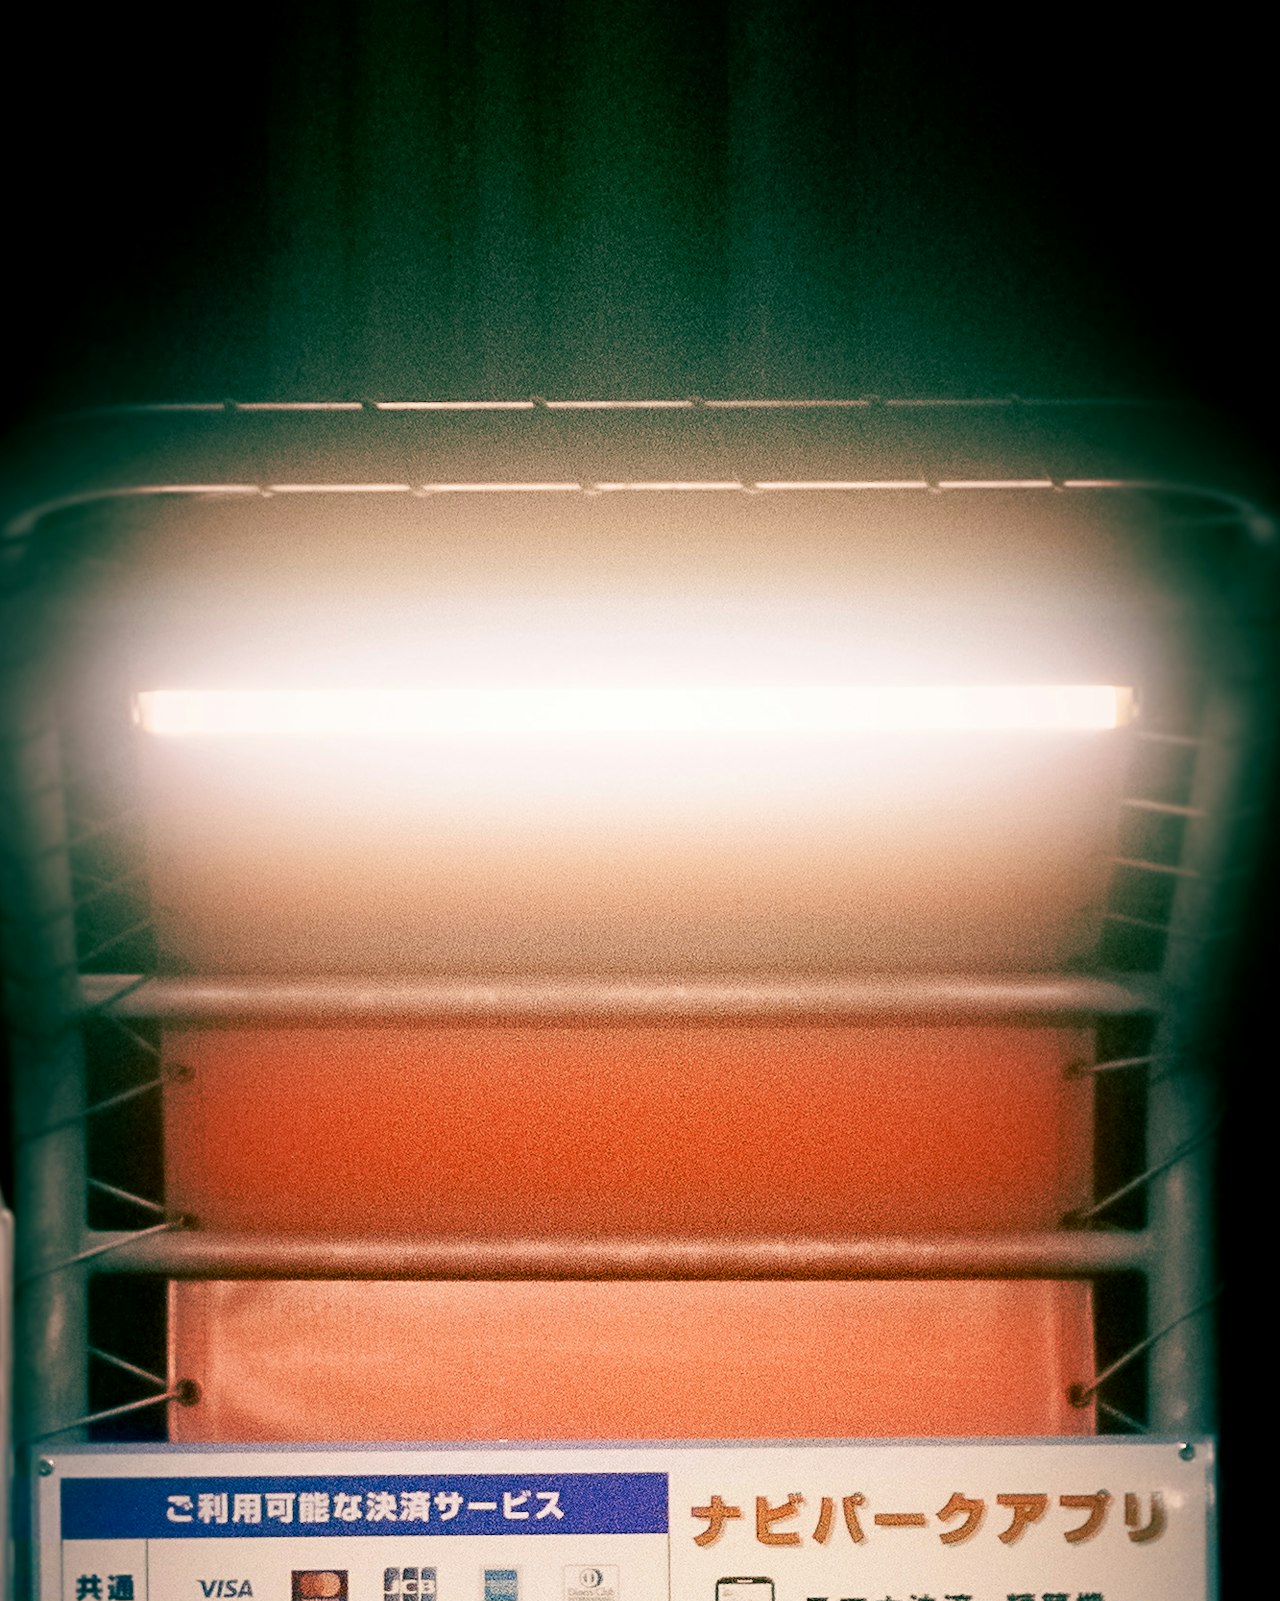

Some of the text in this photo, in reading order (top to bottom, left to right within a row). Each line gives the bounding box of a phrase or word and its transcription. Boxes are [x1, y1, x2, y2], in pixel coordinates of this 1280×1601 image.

[166, 1491, 565, 1524] ご利用可能な決済サービス
[689, 1490, 1172, 1548] ナビパークアプリ
[75, 1574, 135, 1601] 共通
[196, 1578, 254, 1599] VISA
